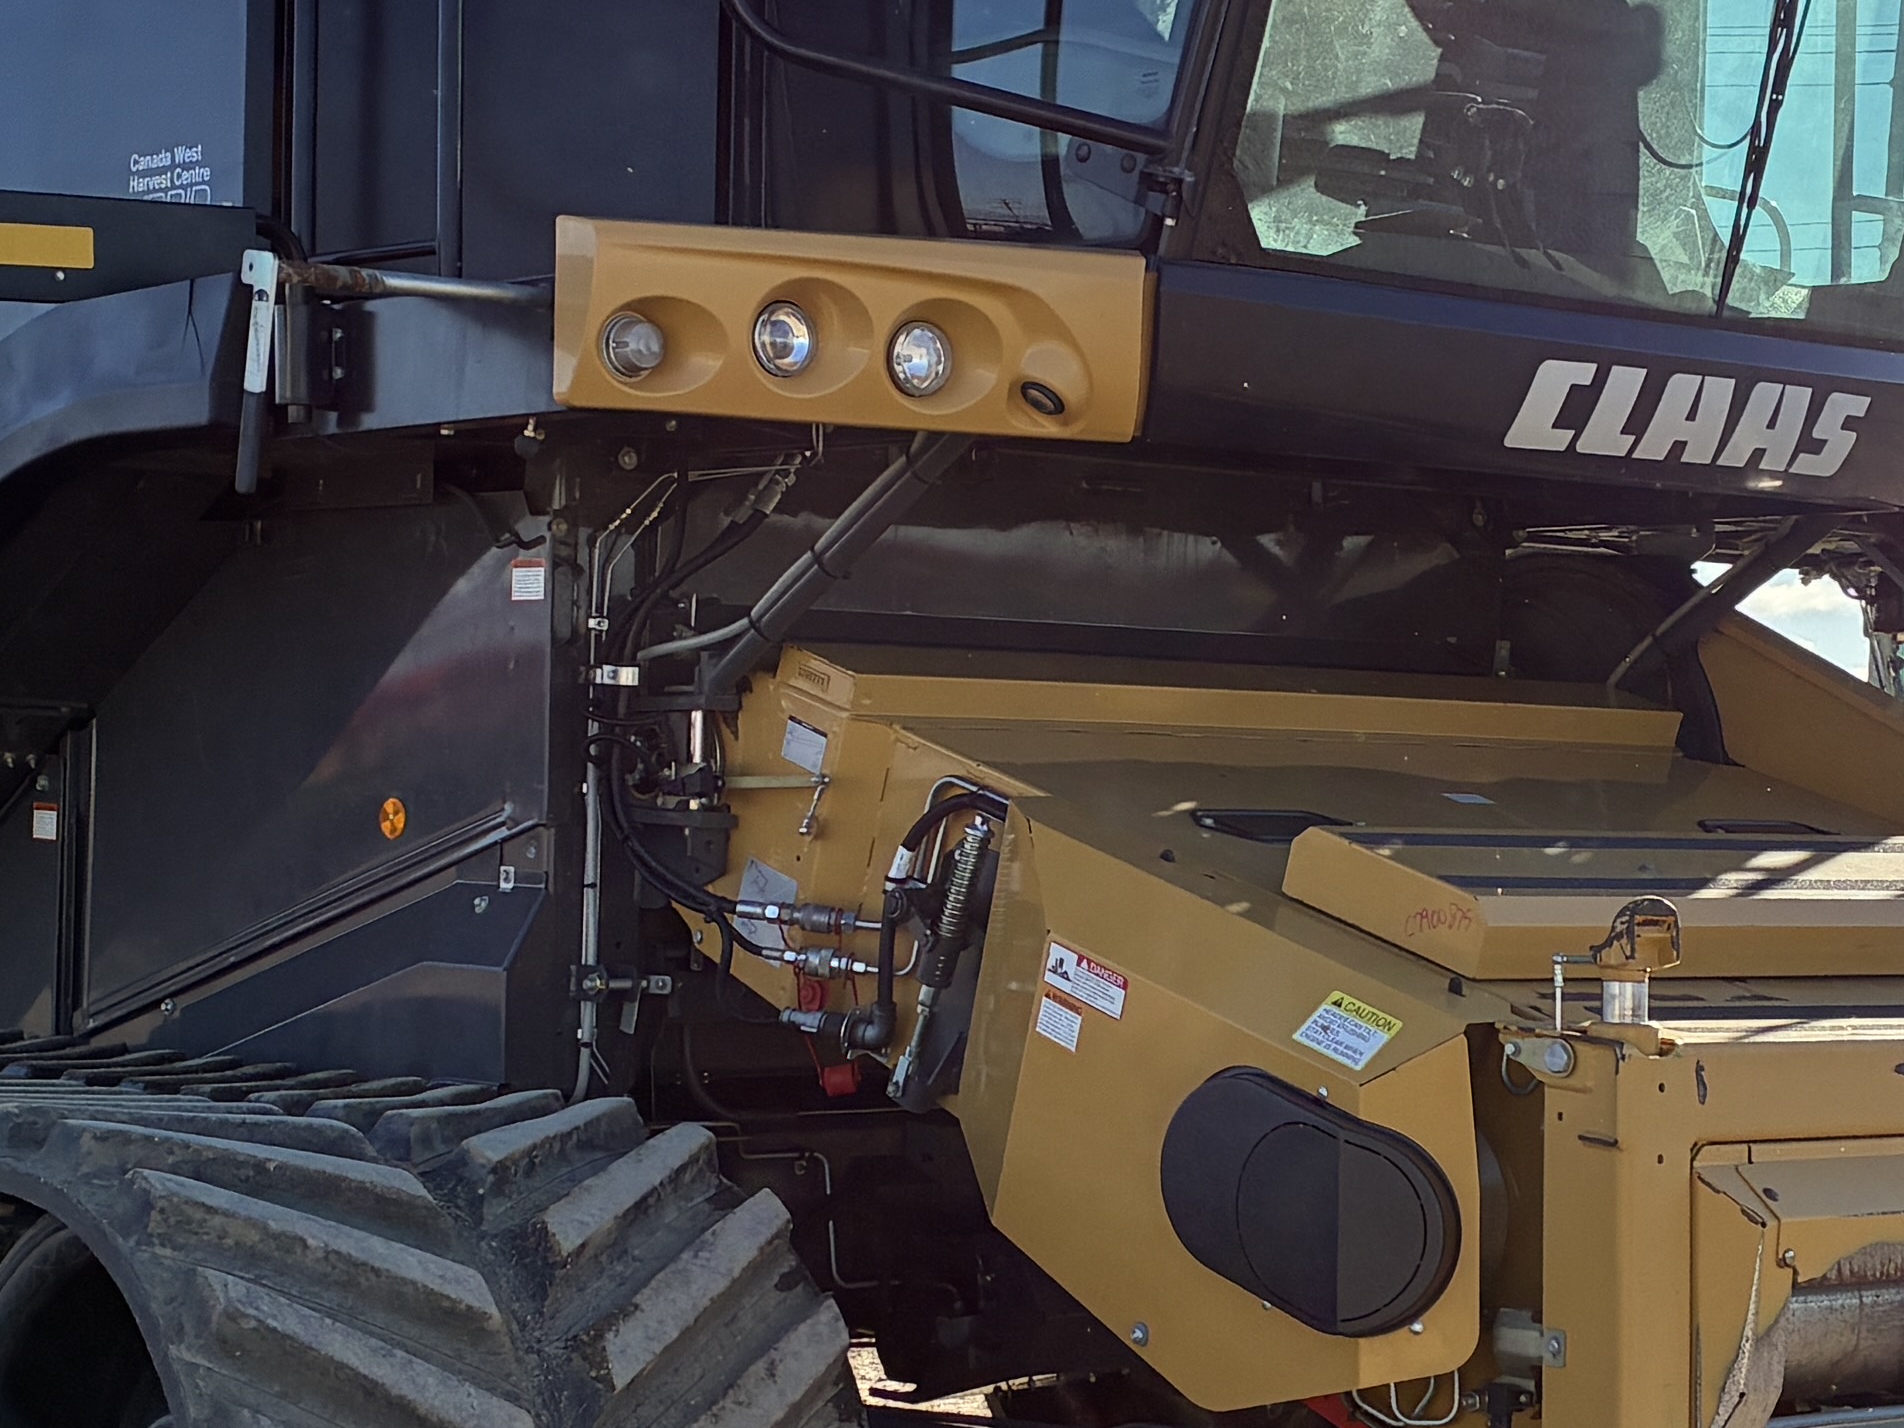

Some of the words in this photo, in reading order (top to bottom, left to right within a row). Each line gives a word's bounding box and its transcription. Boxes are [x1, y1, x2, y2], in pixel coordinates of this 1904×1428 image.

[130, 149, 172, 172] Canada
[174, 144, 202, 164] West
[129, 171, 171, 193] Harvest
[174, 165, 211, 186] Centre
[1503, 359, 1872, 477] CLAAS
[1343, 1001, 1397, 1032] CAUTION
